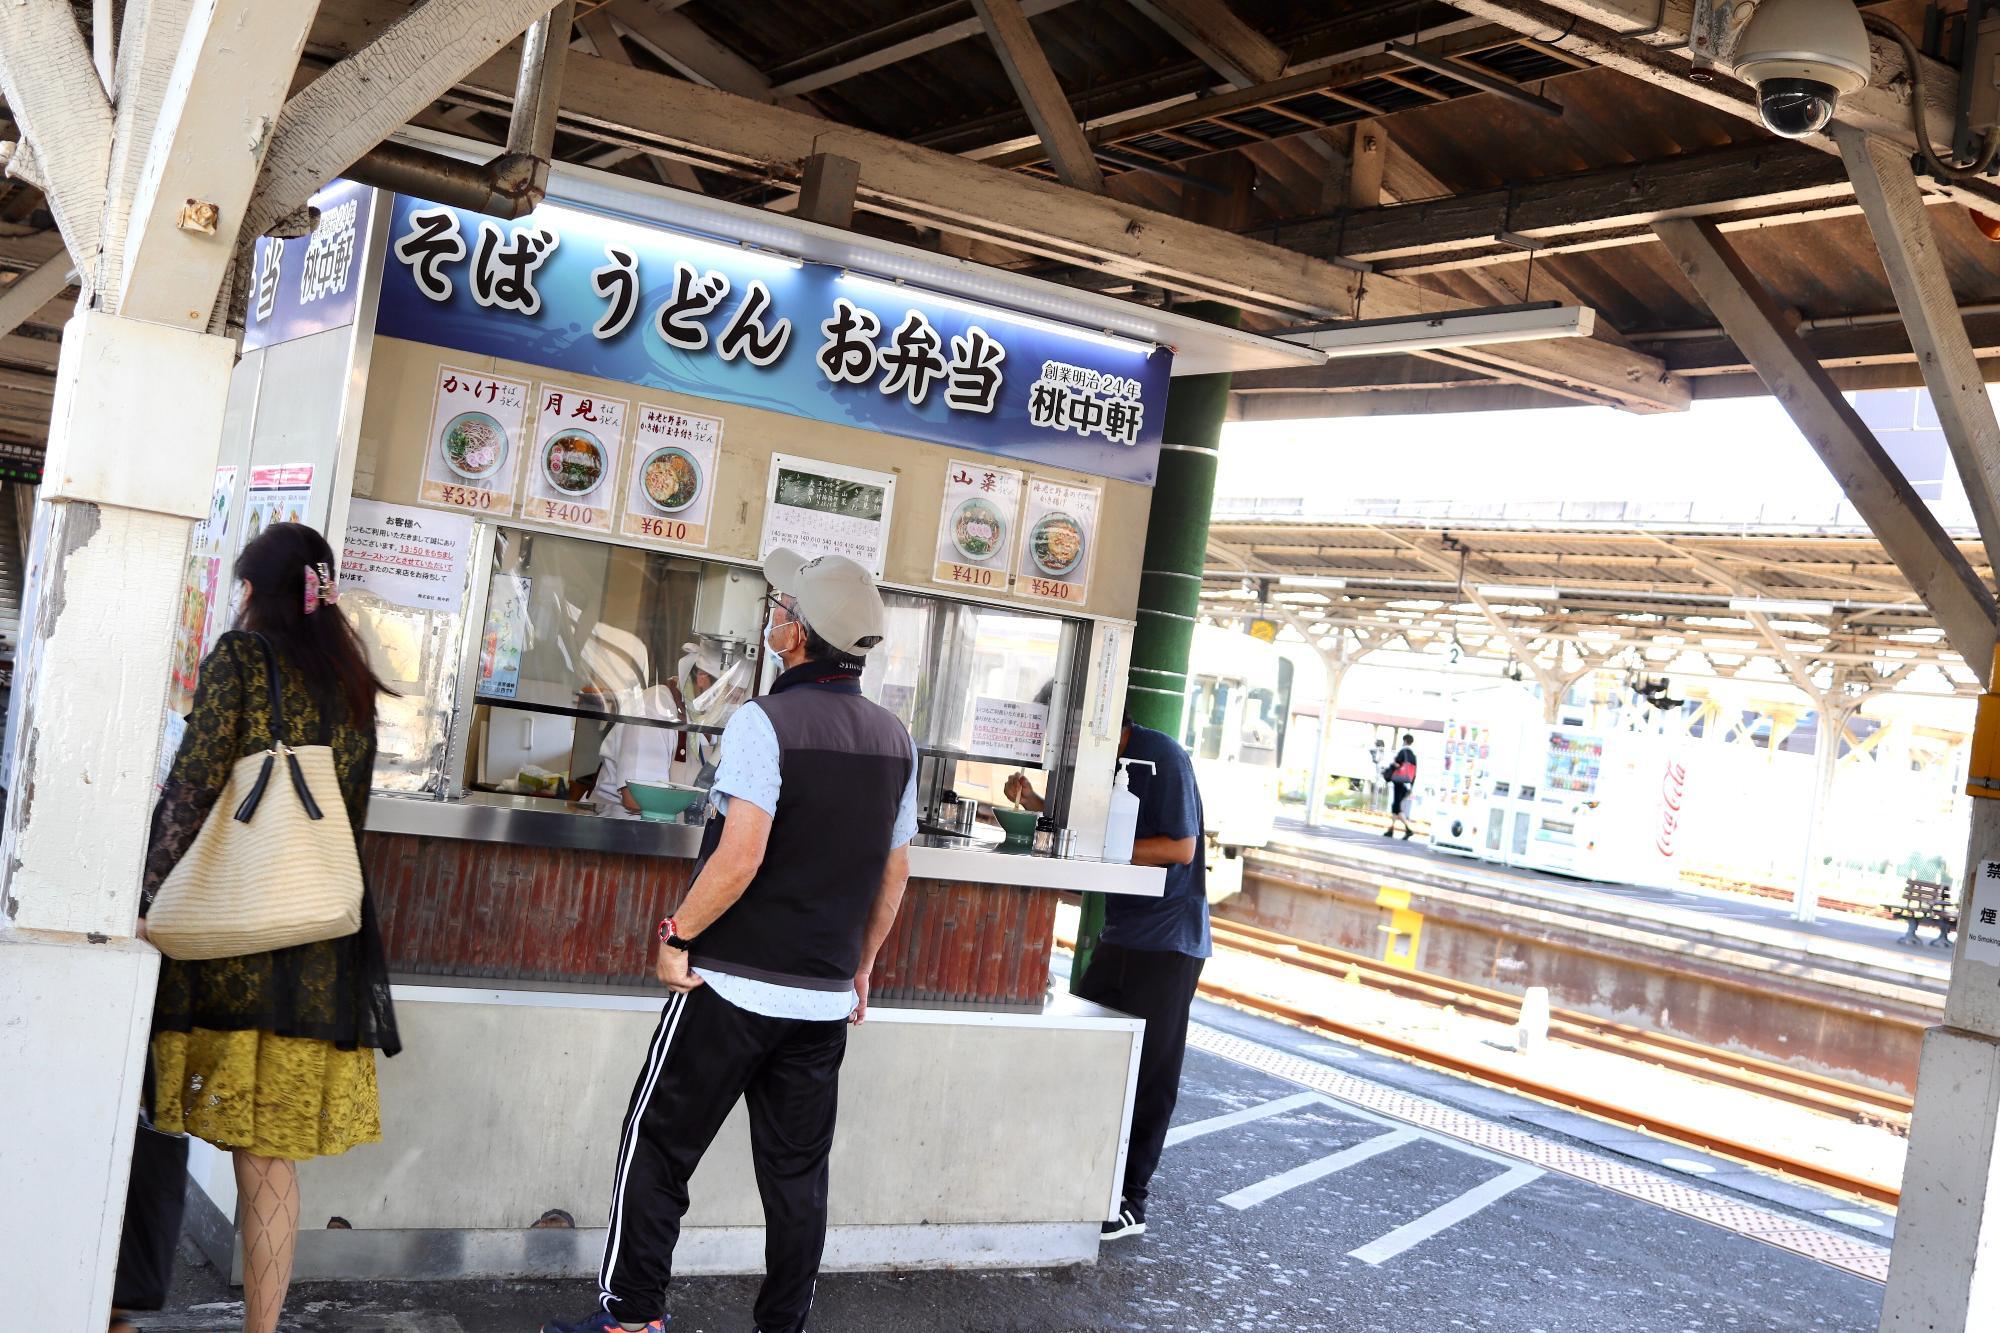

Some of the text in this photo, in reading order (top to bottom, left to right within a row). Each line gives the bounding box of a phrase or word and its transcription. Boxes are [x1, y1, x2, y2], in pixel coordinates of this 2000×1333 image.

[302, 231, 354, 301] 桃中軒
[397, 209, 1003, 410] そば うどん お弁当
[443, 376, 499, 403] かけ
[502, 385, 516, 395] そば
[1043, 362, 1141, 398] 創業明治24年
[500, 397, 521, 409] うどん
[544, 394, 597, 421] 月見
[600, 404, 615, 414] そば
[1031, 382, 1142, 443] 桃中軒
[599, 416, 620, 427] うどん
[953, 470, 997, 492] 山菜
[442, 485, 491, 508] ¥330
[386, 516, 422, 529] お客様へ
[545, 502, 592, 524] ¥400
[641, 517, 687, 540] ¥610
[953, 565, 991, 585] ¥410
[1032, 578, 1069, 599] ¥540
[1450, 648, 1458, 664] 2
[1969, 933, 1976, 941] No
